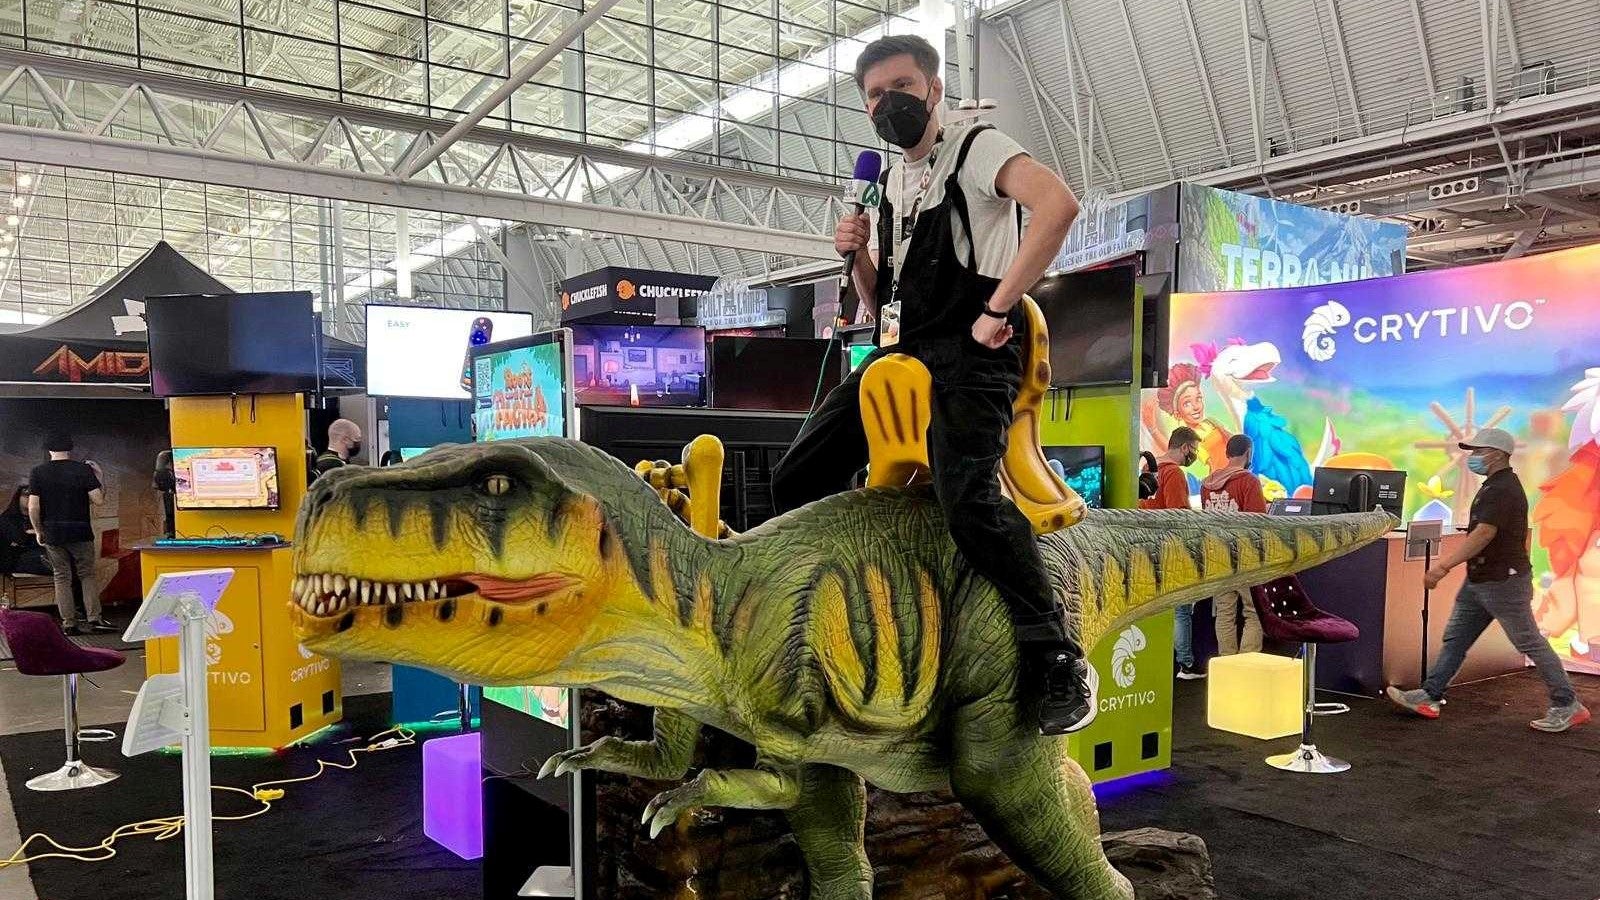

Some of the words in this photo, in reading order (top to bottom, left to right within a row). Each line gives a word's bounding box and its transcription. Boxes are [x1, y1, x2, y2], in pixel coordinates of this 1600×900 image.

[571, 283, 608, 305] CHUCKLEFISH
[387, 320, 410, 328] EASY
[1353, 300, 1535, 344] CRYTIVO
[207, 671, 251, 685] TIVO
[290, 658, 330, 683] CRYTIVO
[1099, 690, 1156, 713] CRYTIVO
